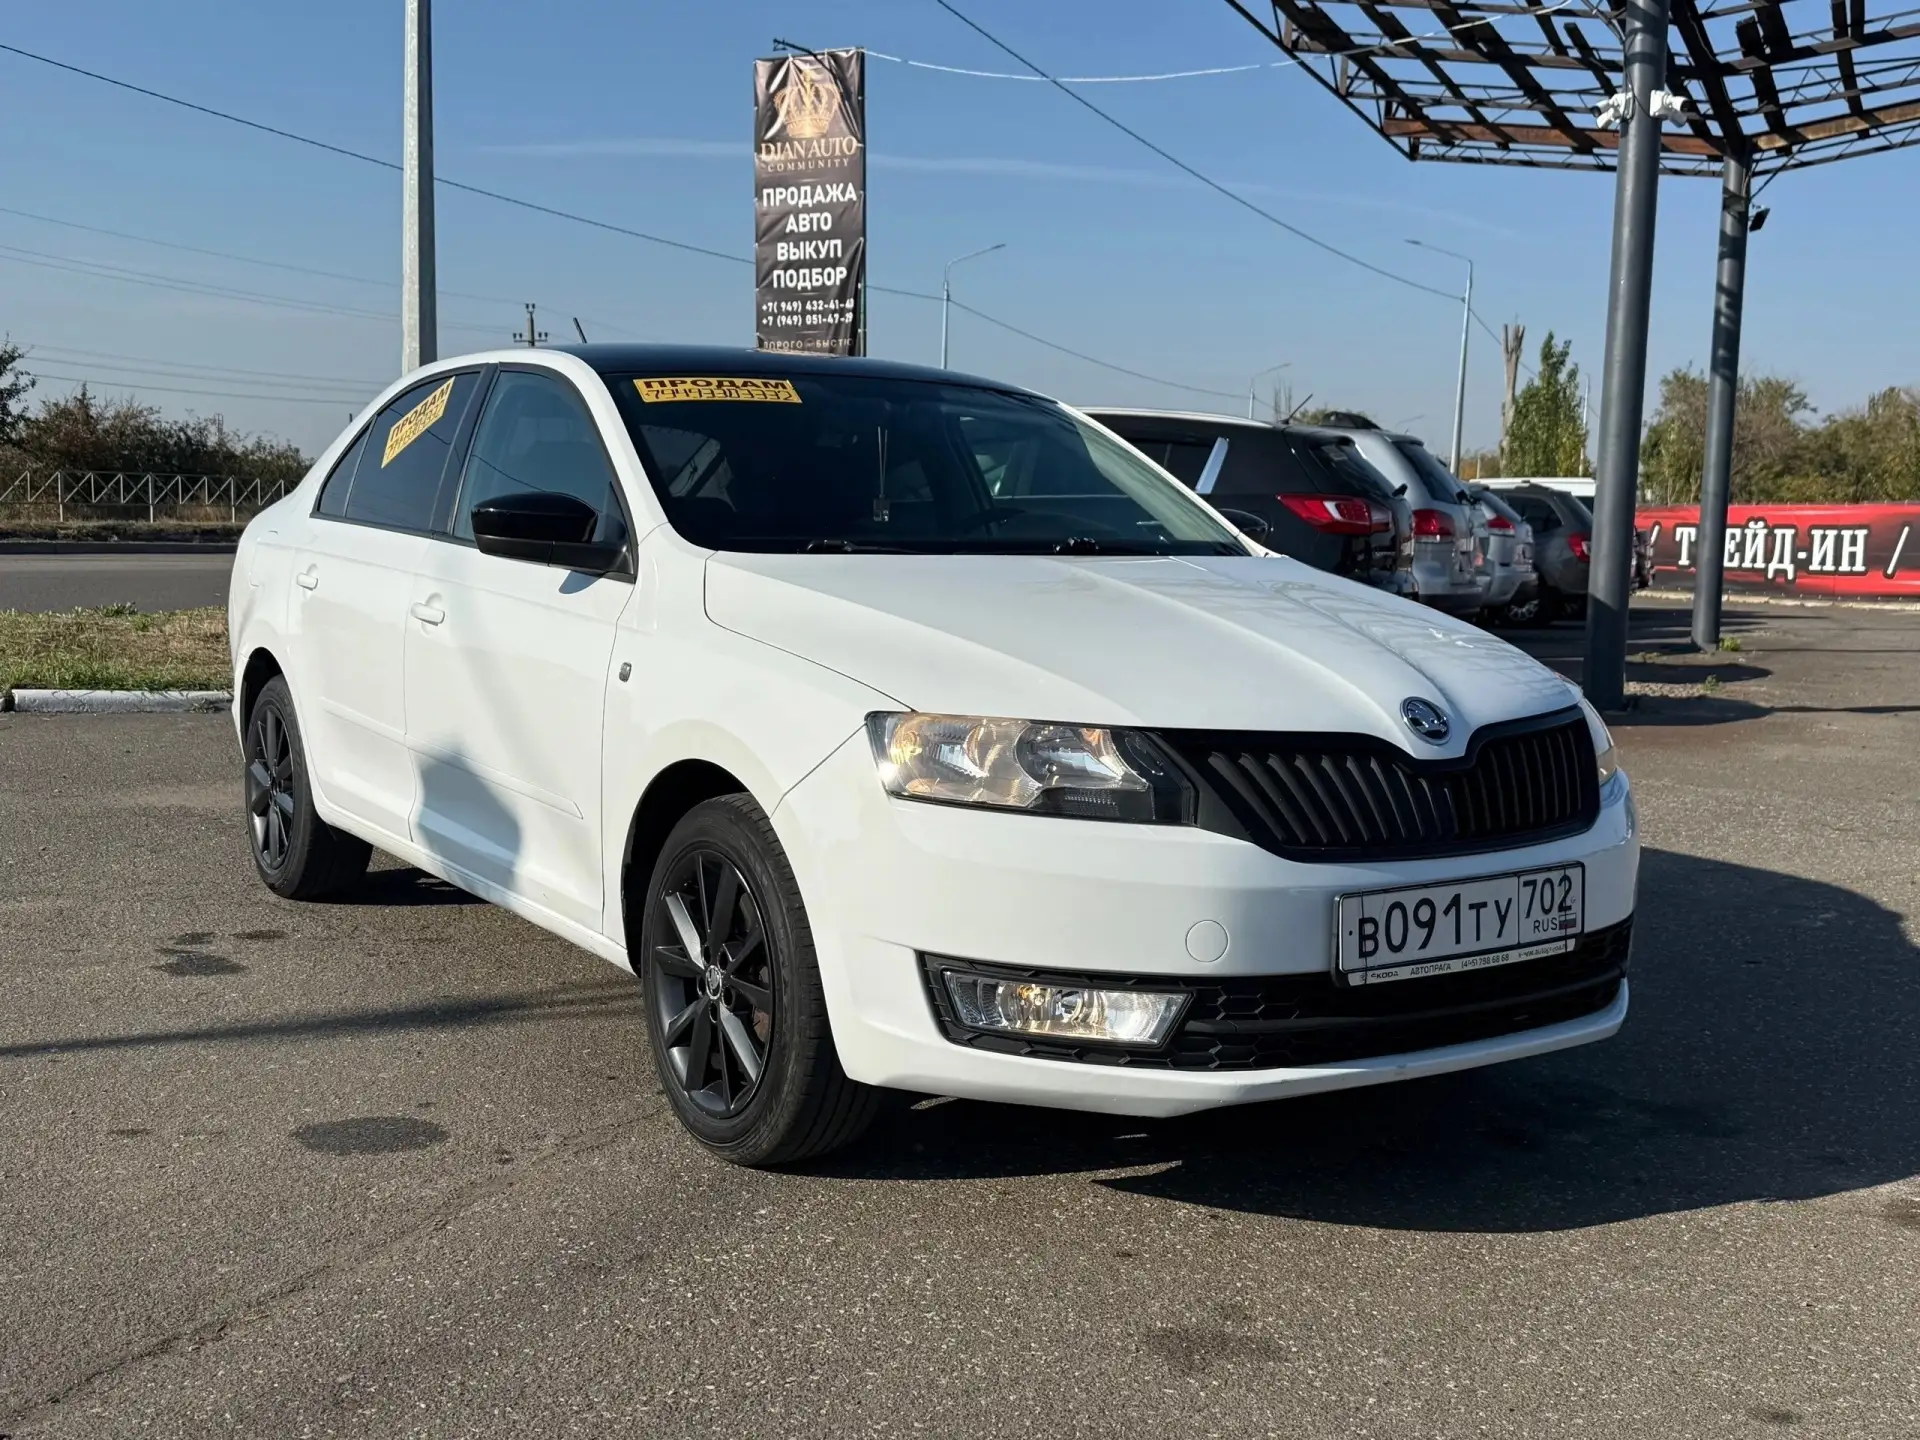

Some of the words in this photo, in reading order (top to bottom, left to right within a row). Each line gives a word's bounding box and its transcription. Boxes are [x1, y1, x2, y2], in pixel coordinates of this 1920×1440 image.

[767, 158, 849, 172] COMMUNITY
[762, 183, 857, 208] ПРОДАЖА
[785, 212, 832, 233] АВТО
[777, 239, 842, 261] ВЫКУП
[772, 267, 847, 290] ПОДБОР
[643, 379, 788, 390] ПРОДАМ
[391, 382, 451, 442] ПРОДАМ
[1675, 521, 1868, 580] ТЕЙД-ИН
[1523, 874, 1573, 919] 702
[1533, 917, 1558, 934] RUS
[1410, 963, 1452, 976] АВТОПРАГА
